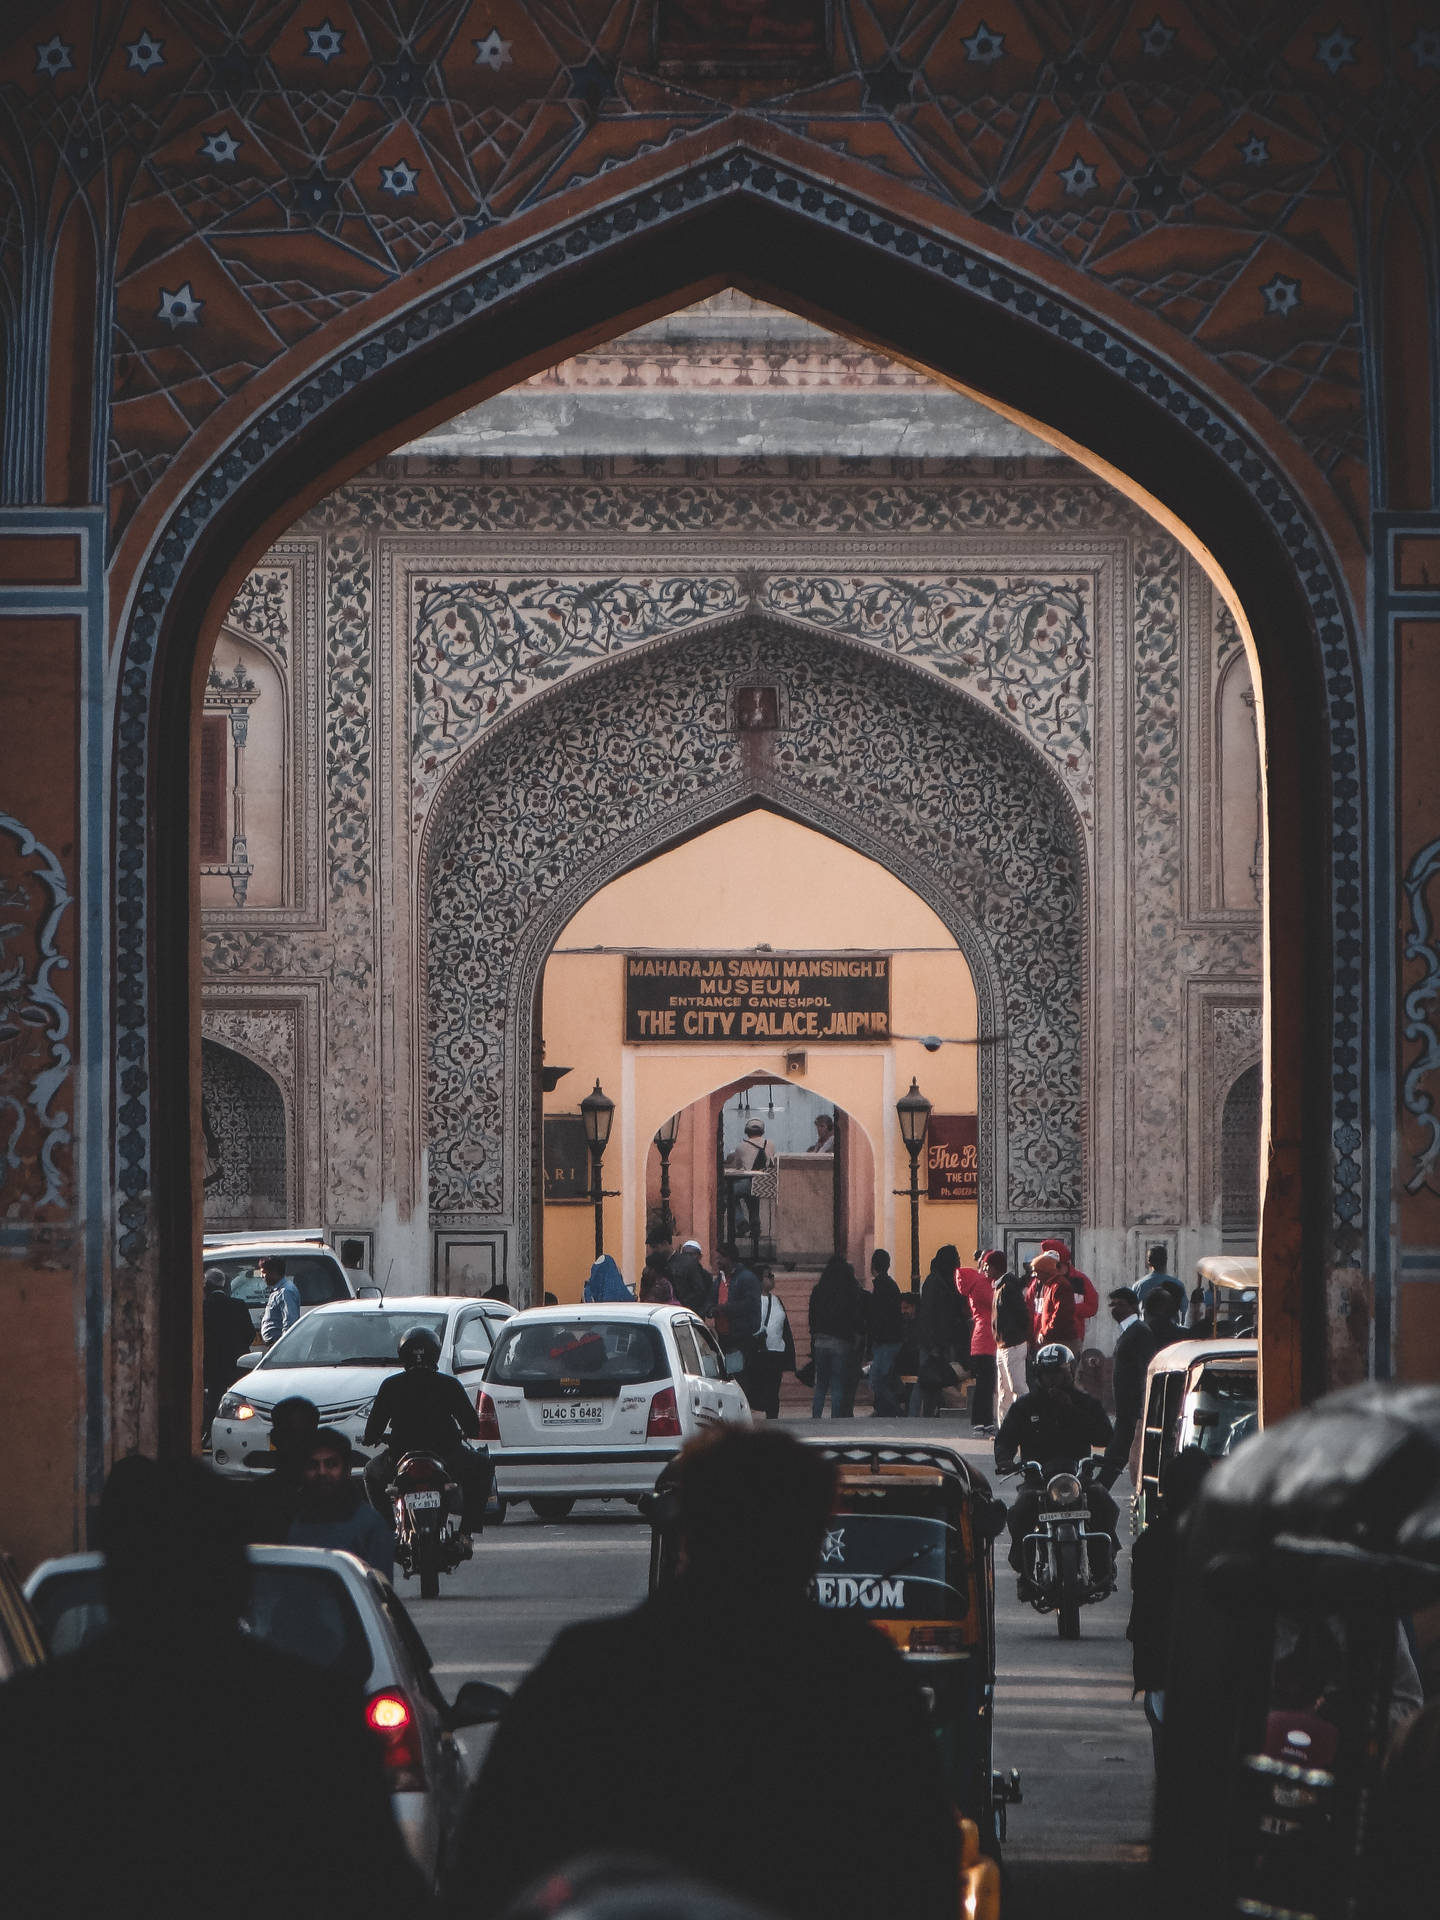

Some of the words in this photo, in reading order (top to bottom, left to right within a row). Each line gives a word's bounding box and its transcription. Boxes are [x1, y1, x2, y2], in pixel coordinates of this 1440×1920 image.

[629, 960, 725, 977] MAHARAJA
[728, 960, 779, 977] SAWAI
[783, 960, 872, 978] MANSINGH
[700, 979, 800, 995] MUSEUM
[669, 996, 742, 1007] ENTRANCE
[748, 996, 831, 1008] GANESHPOL
[637, 1010, 676, 1035] THE
[683, 1012, 736, 1035] CITY
[928, 1143, 959, 1169] The
[945, 1172, 962, 1183] THE
[543, 1408, 567, 1419] DL4C
[570, 1408, 576, 1418] S
[579, 1407, 602, 1418] 6482
[806, 1577, 905, 1608] EDOM
